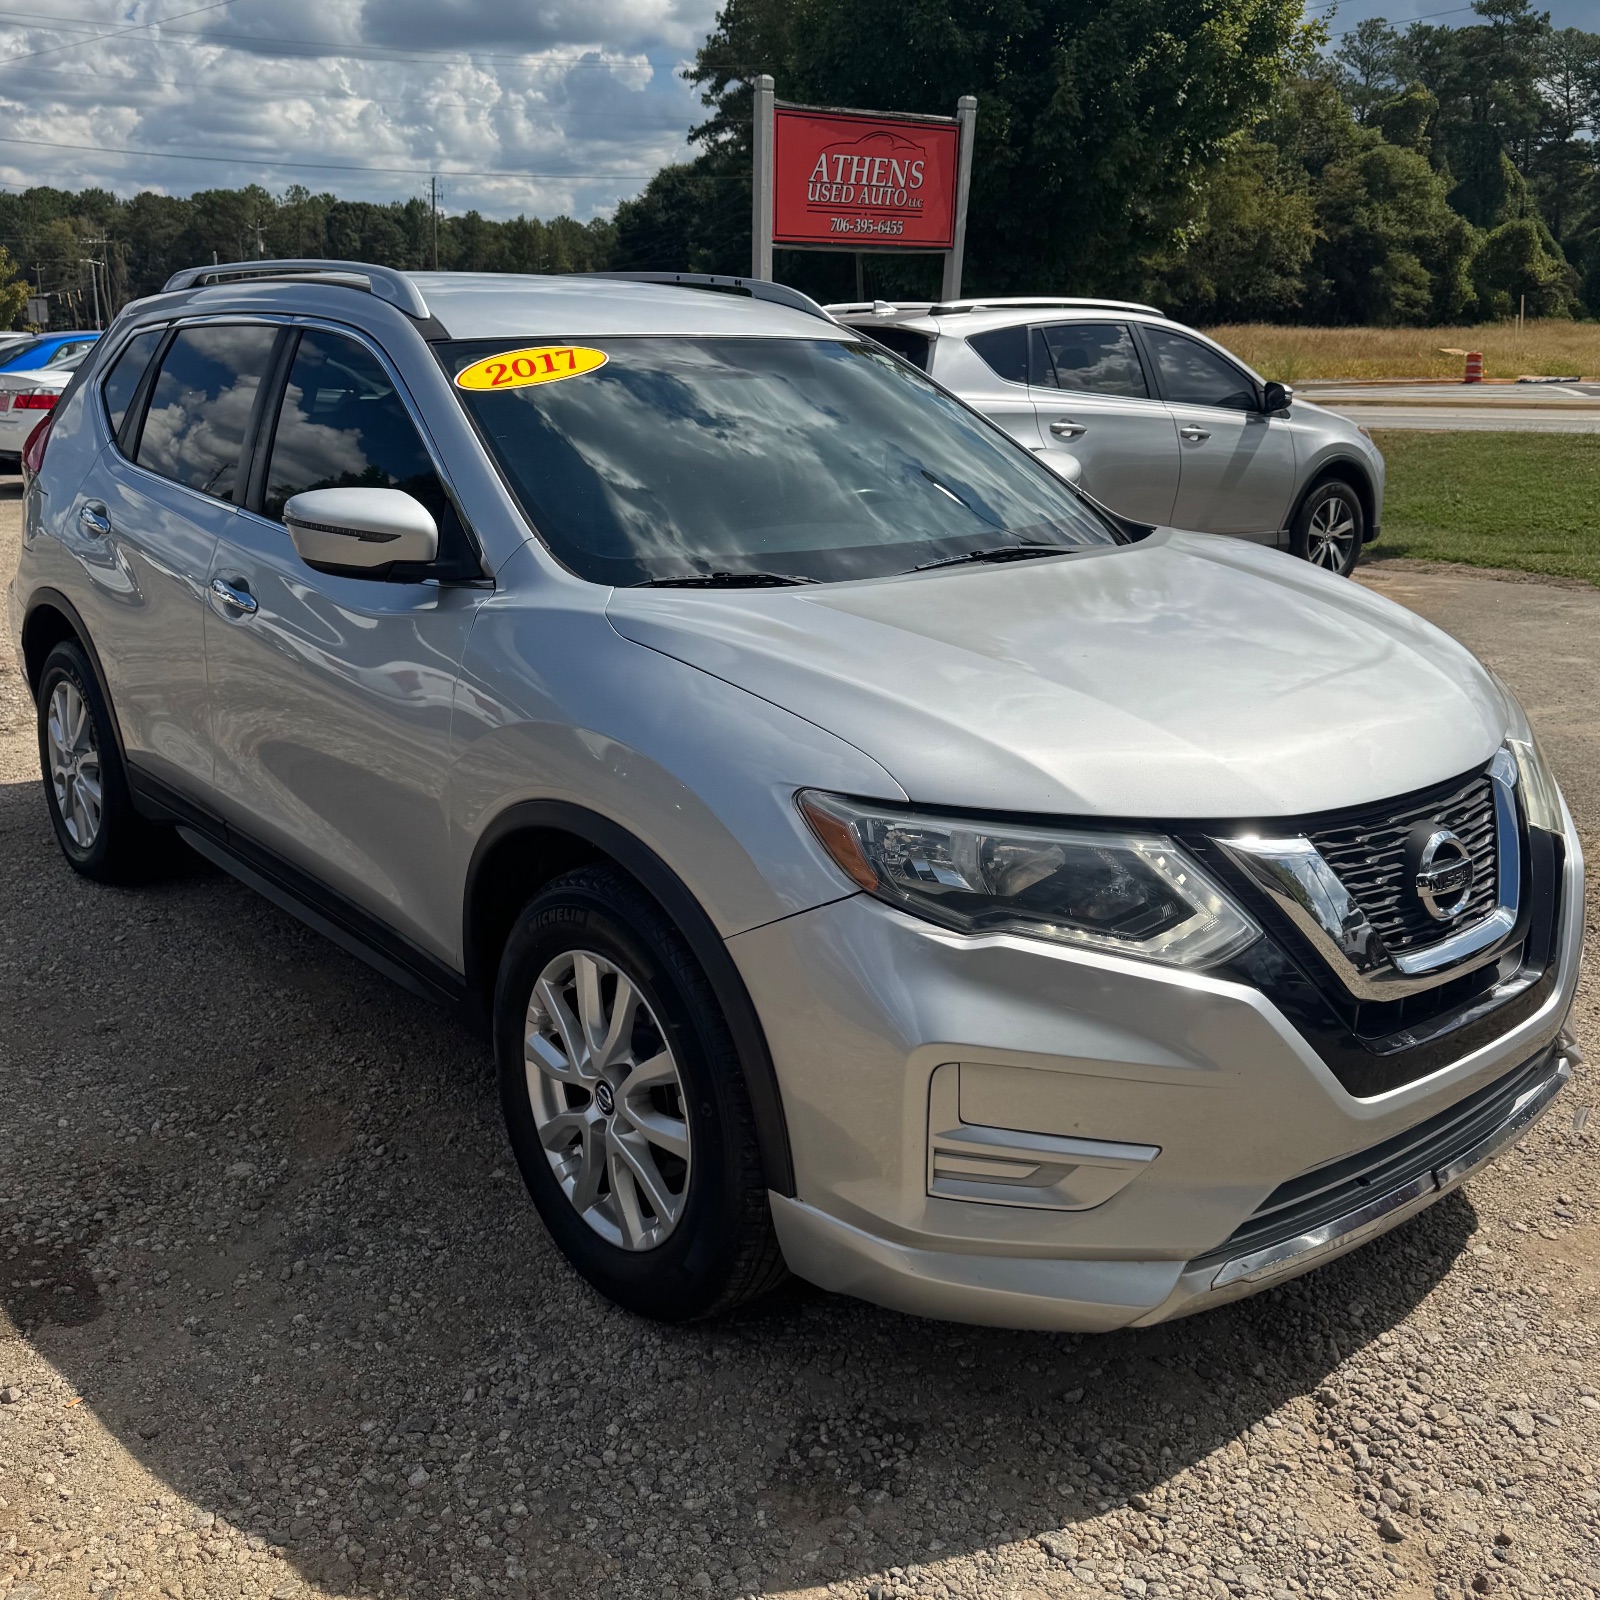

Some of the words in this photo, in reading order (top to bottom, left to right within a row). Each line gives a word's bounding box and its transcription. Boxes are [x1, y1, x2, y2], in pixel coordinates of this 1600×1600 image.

[808, 153, 925, 189] ATHENS
[807, 182, 855, 204] USED
[857, 186, 908, 207] AUTO
[908, 198, 923, 208] LLC
[830, 217, 904, 235] 706-395-6455
[485, 349, 576, 386] 2017
[529, 908, 584, 931] MICHELIN
